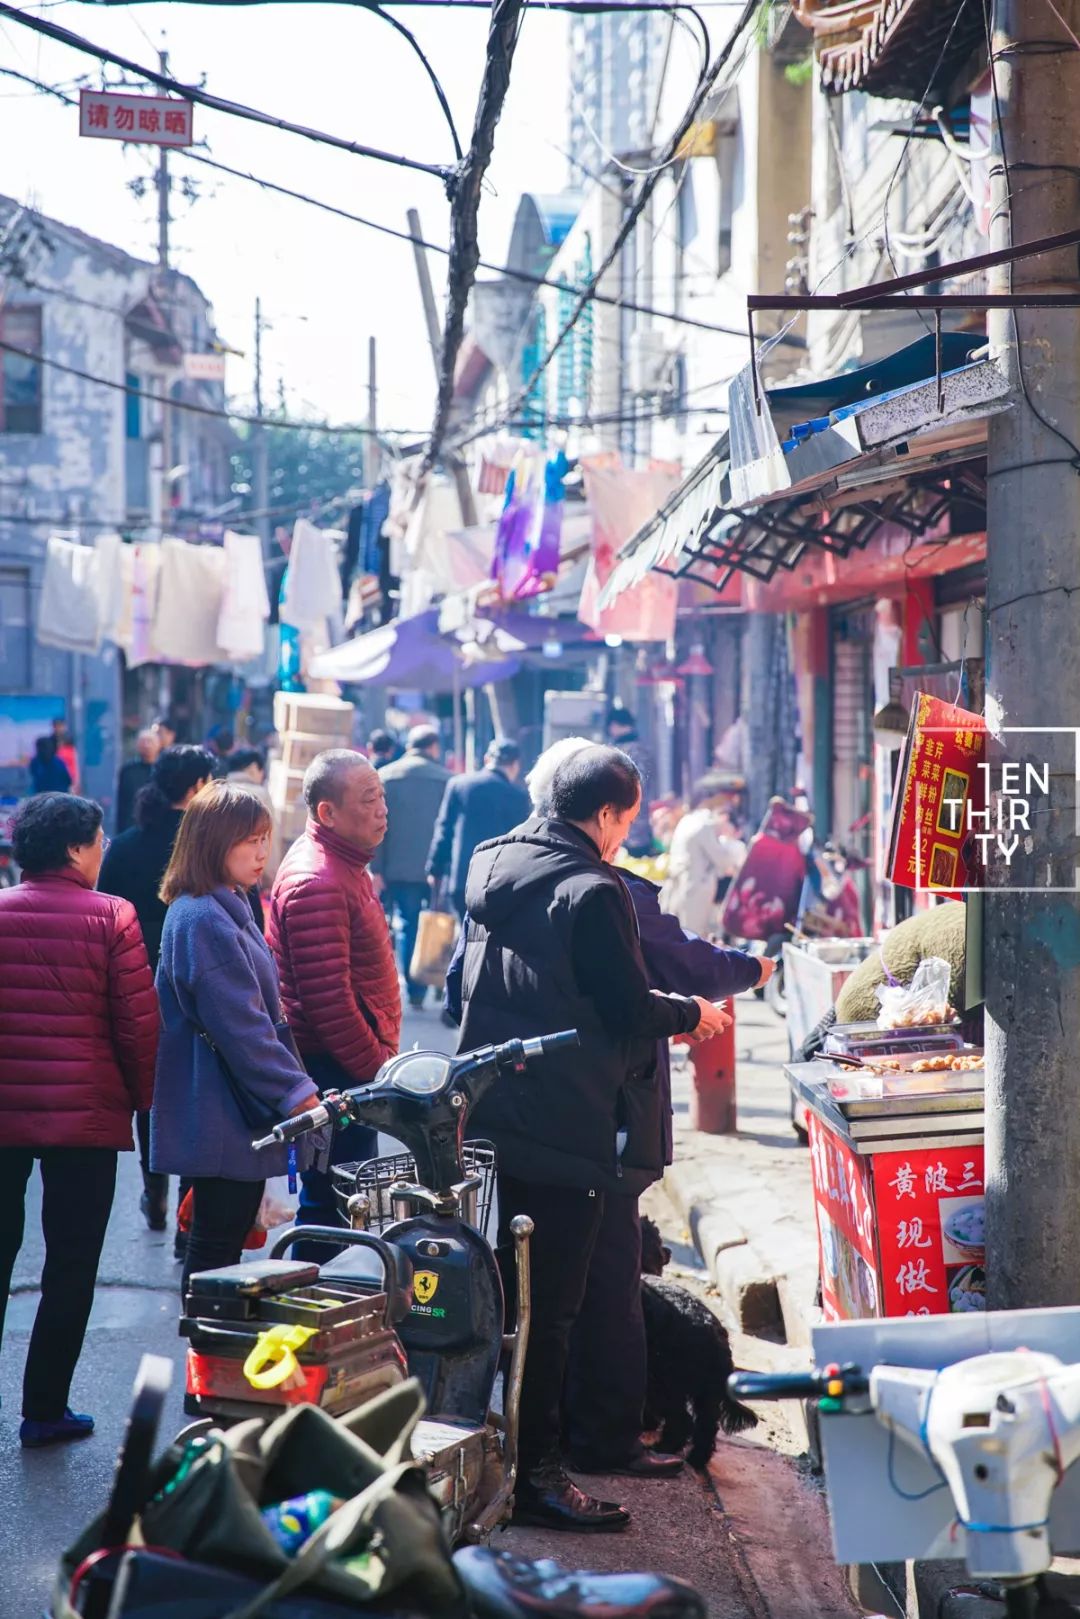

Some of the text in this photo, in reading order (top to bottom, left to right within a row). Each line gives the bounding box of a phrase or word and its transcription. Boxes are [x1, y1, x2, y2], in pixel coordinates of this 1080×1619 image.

[88, 103, 186, 134] 请勿晾晒
[888, 1161, 983, 1200] 黄陂三
[895, 1216, 938, 1317] 现做
